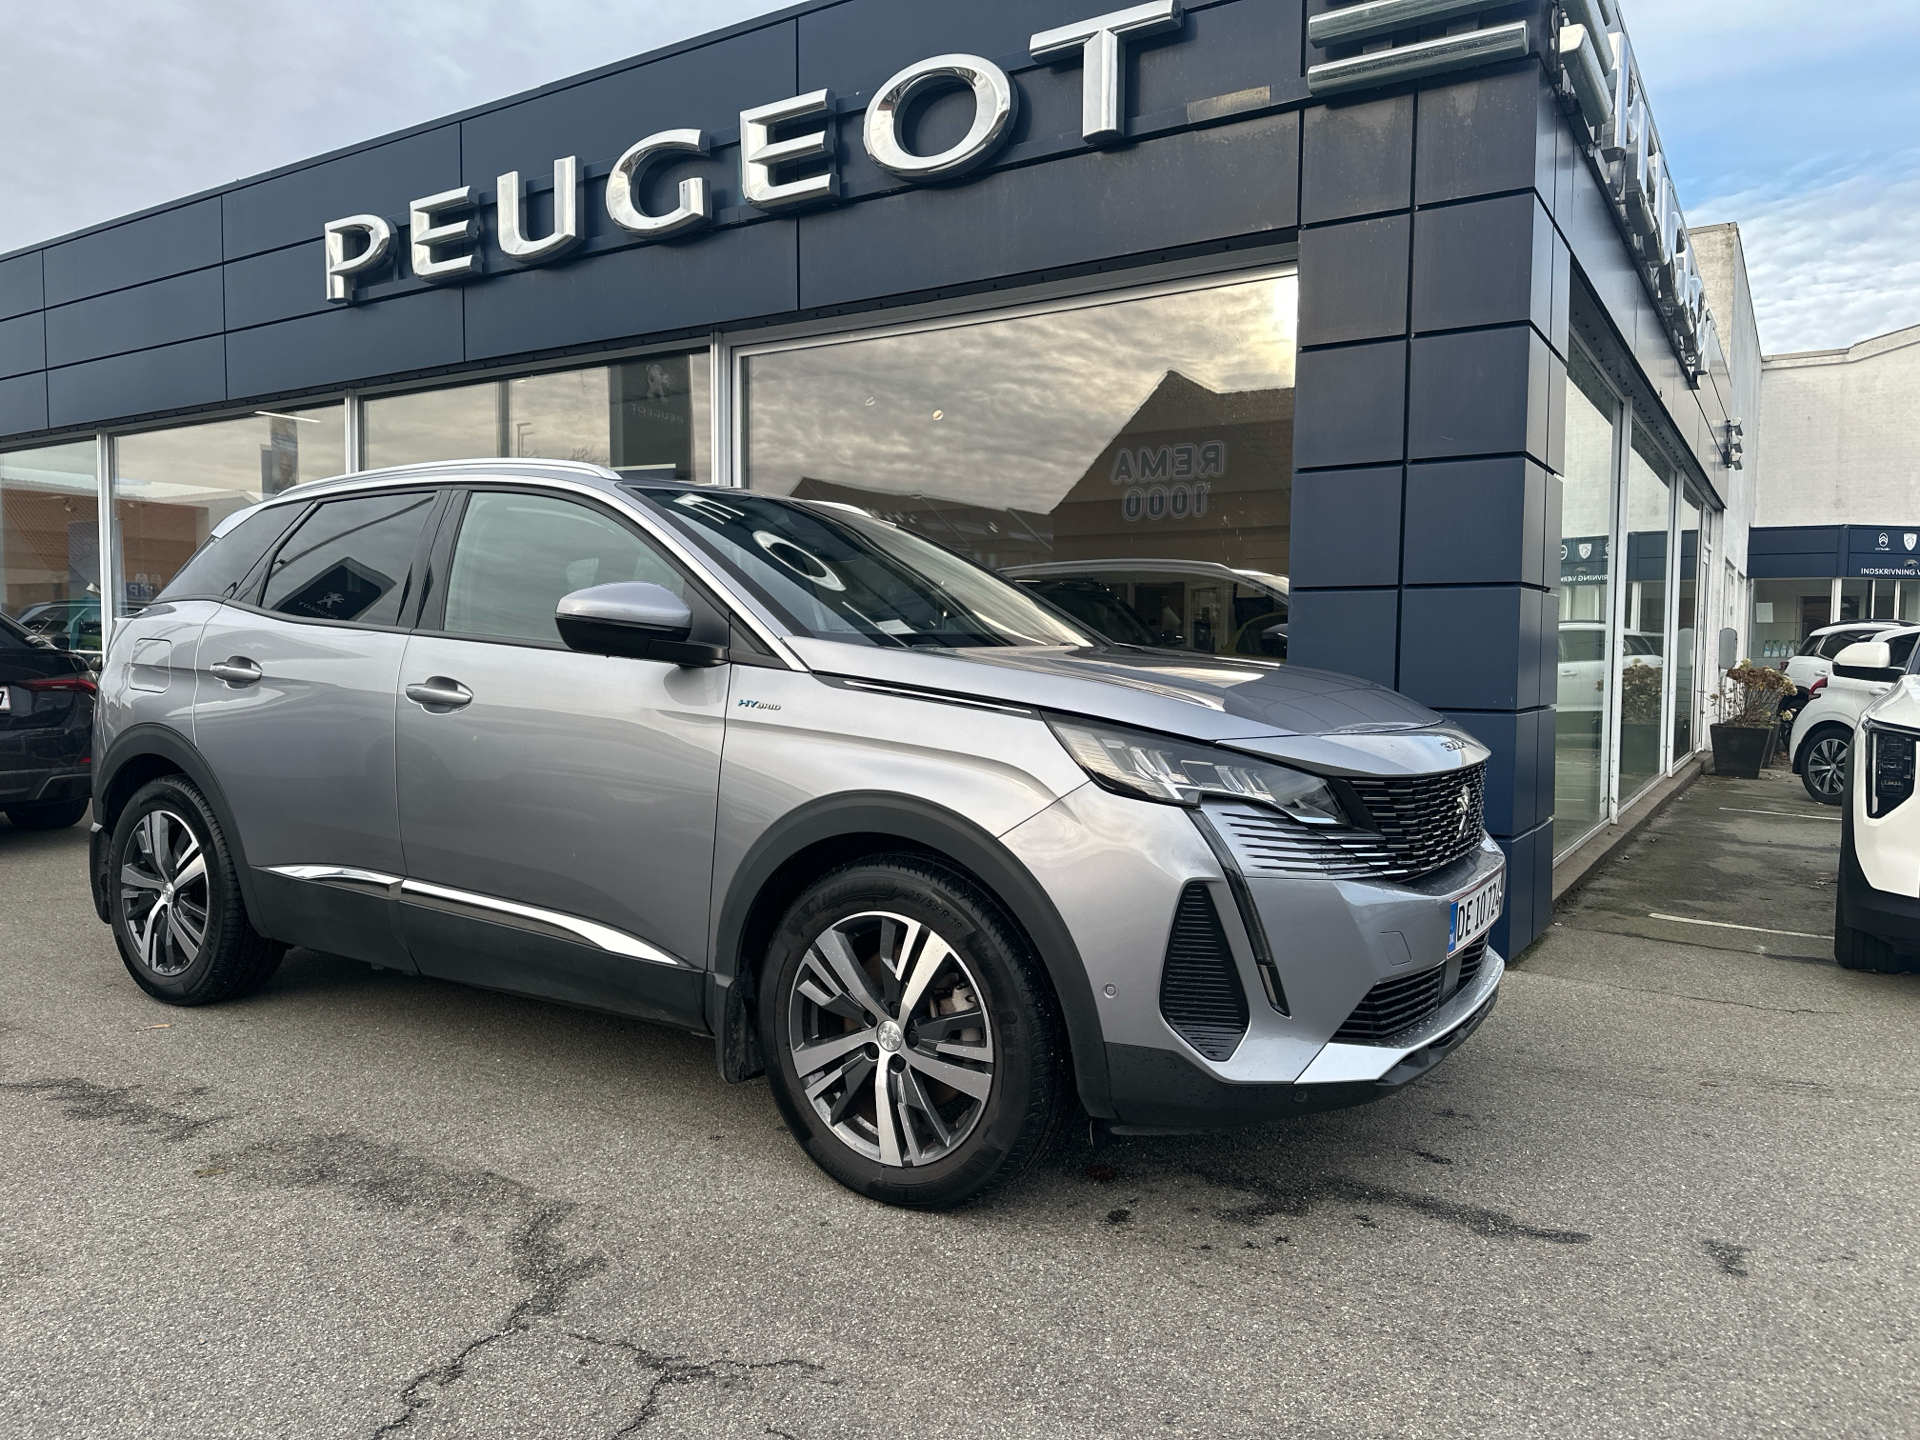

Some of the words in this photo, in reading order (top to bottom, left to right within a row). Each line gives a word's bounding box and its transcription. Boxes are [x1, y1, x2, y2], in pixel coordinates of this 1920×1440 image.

[324, 0, 1185, 305] PEUGEOT
[1860, 567, 1916, 576] INDSKRIVNING
[1456, 899, 1473, 943] DE
[1474, 889, 1486, 930] 10
